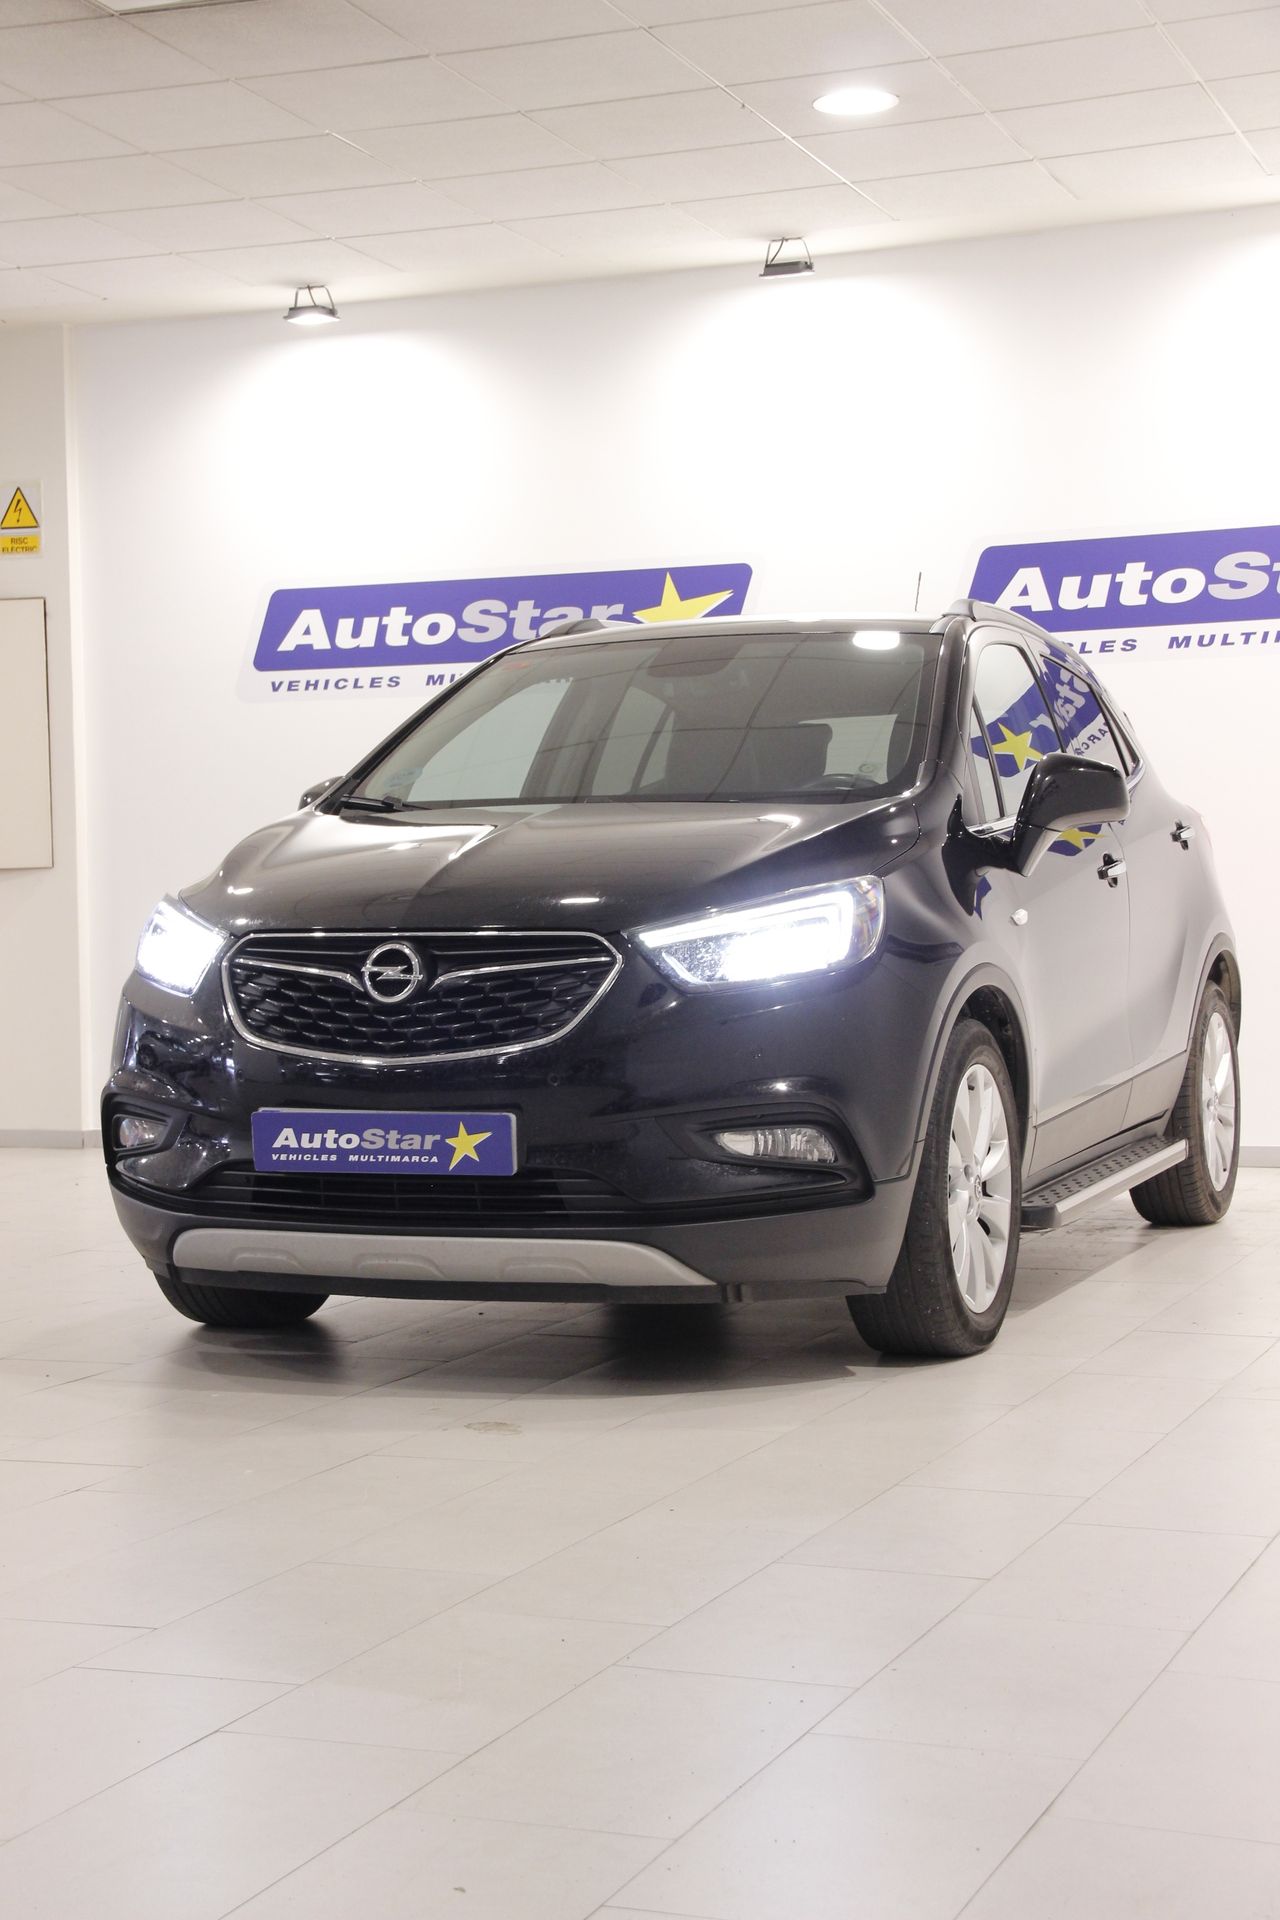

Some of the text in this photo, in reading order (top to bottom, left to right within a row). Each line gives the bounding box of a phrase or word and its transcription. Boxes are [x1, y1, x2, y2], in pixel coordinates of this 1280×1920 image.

[10, 537, 28, 545] RISC
[1064, 630, 1280, 655] LES MULTI
[270, 675, 401, 693] VEHICLES
[271, 1127, 440, 1150] AutoStar
[271, 1153, 439, 1163] VEHICLES MULTIMARCA
